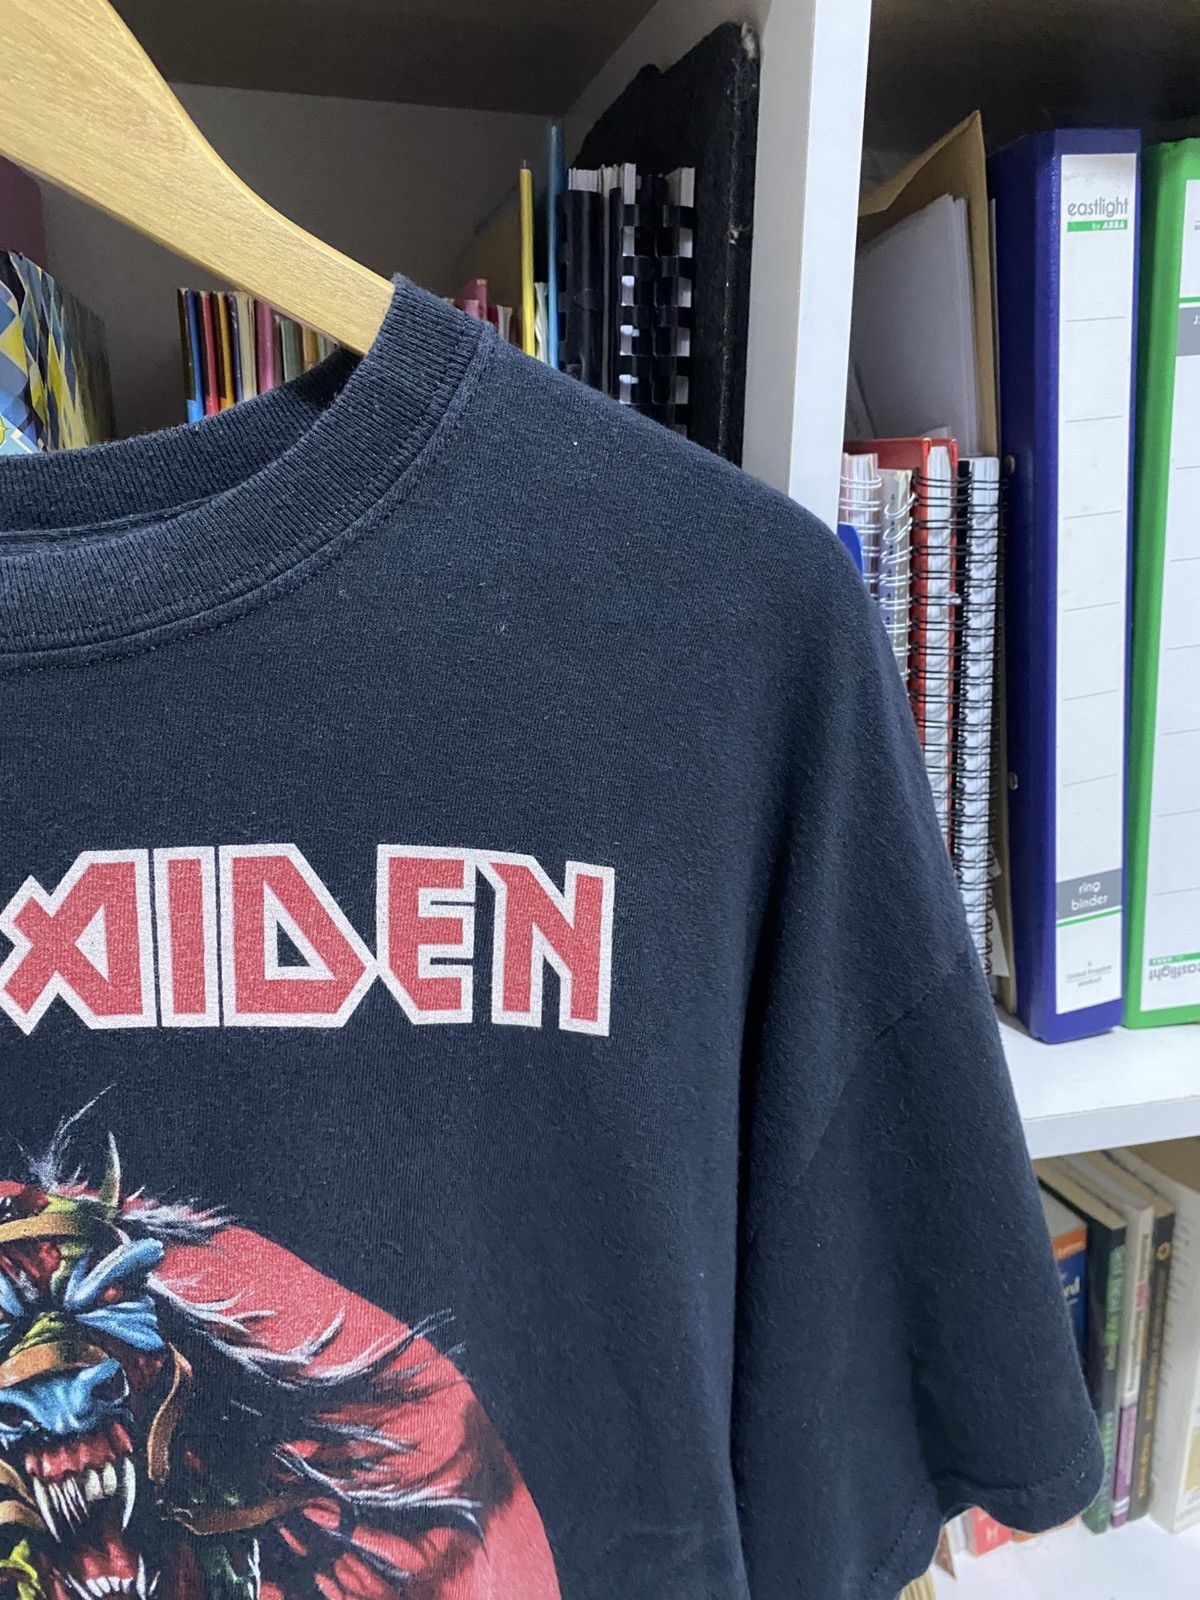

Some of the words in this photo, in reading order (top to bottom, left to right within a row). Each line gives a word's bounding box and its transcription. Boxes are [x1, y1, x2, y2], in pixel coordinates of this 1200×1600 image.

[1067, 197, 1128, 218] eastlight
[1079, 882, 1101, 894] ring
[1071, 895, 1108, 911] binder
[0, 842, 615, 1036] AIDEN
